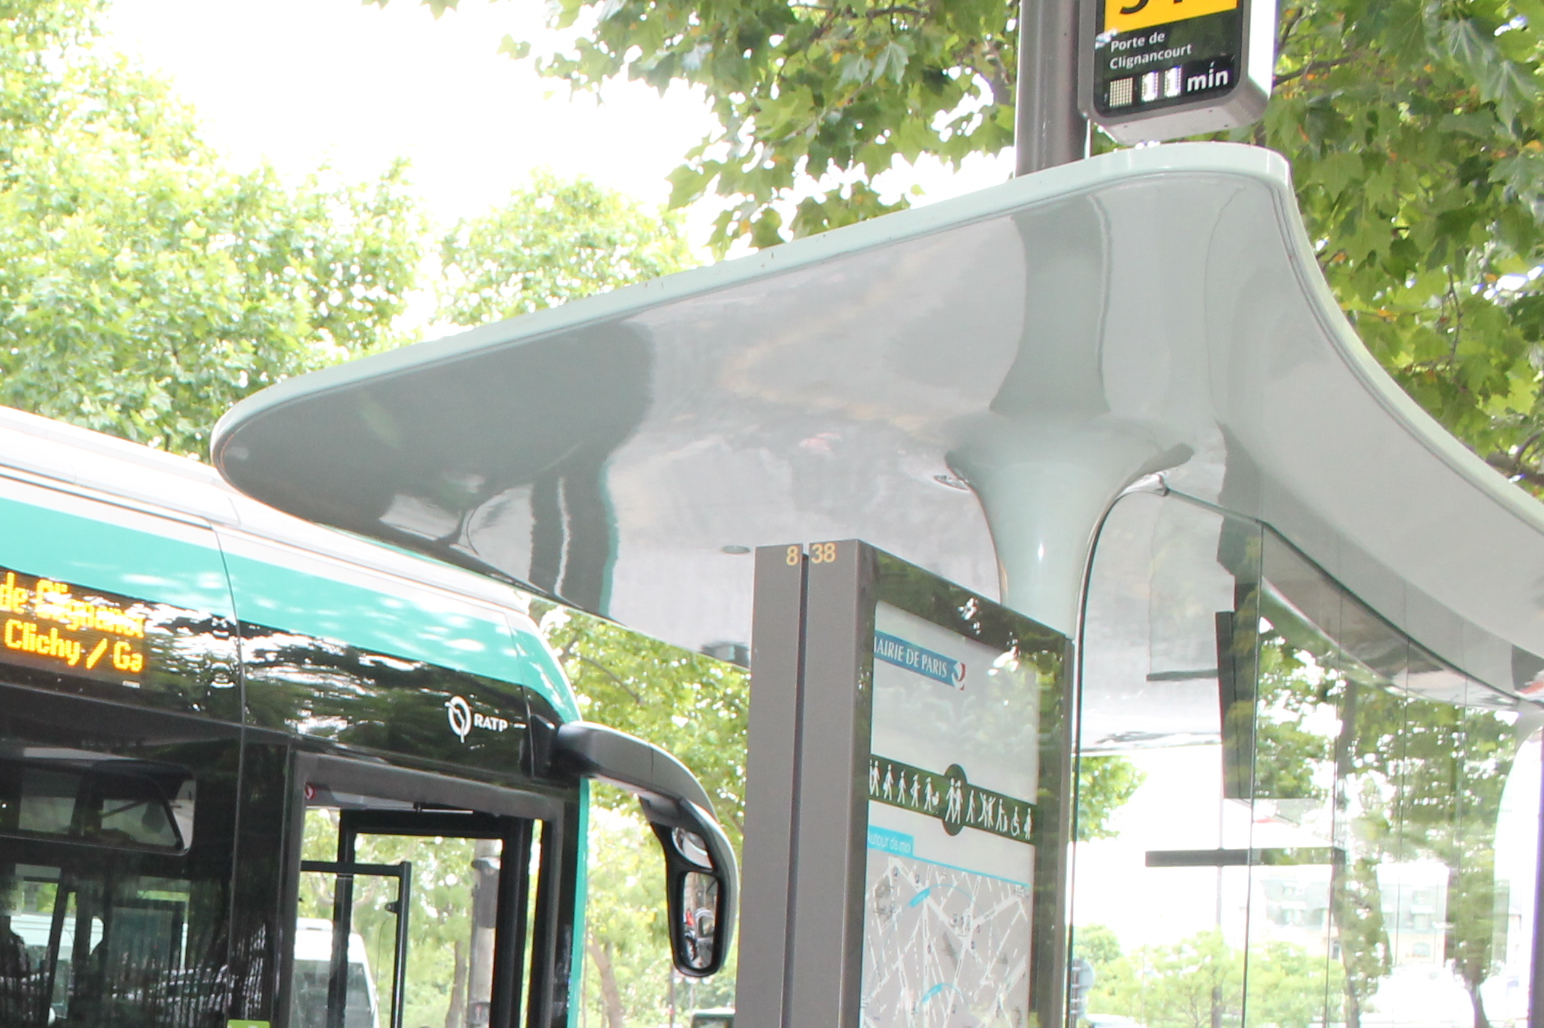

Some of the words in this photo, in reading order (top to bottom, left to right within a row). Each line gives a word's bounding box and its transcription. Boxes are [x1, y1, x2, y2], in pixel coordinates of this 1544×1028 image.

[1111, 36, 1145, 52] Porte
[1149, 31, 1165, 43] de
[1109, 44, 1192, 70] Clignancourt
[1186, 61, 1229, 92] min
[786, 545, 800, 566] 8
[810, 542, 837, 563] 38
[5, 618, 81, 667] Clichy
[113, 641, 144, 673] Ga
[906, 648, 919, 668] DE
[921, 654, 948, 678] PARIS
[474, 713, 509, 732] RATP
